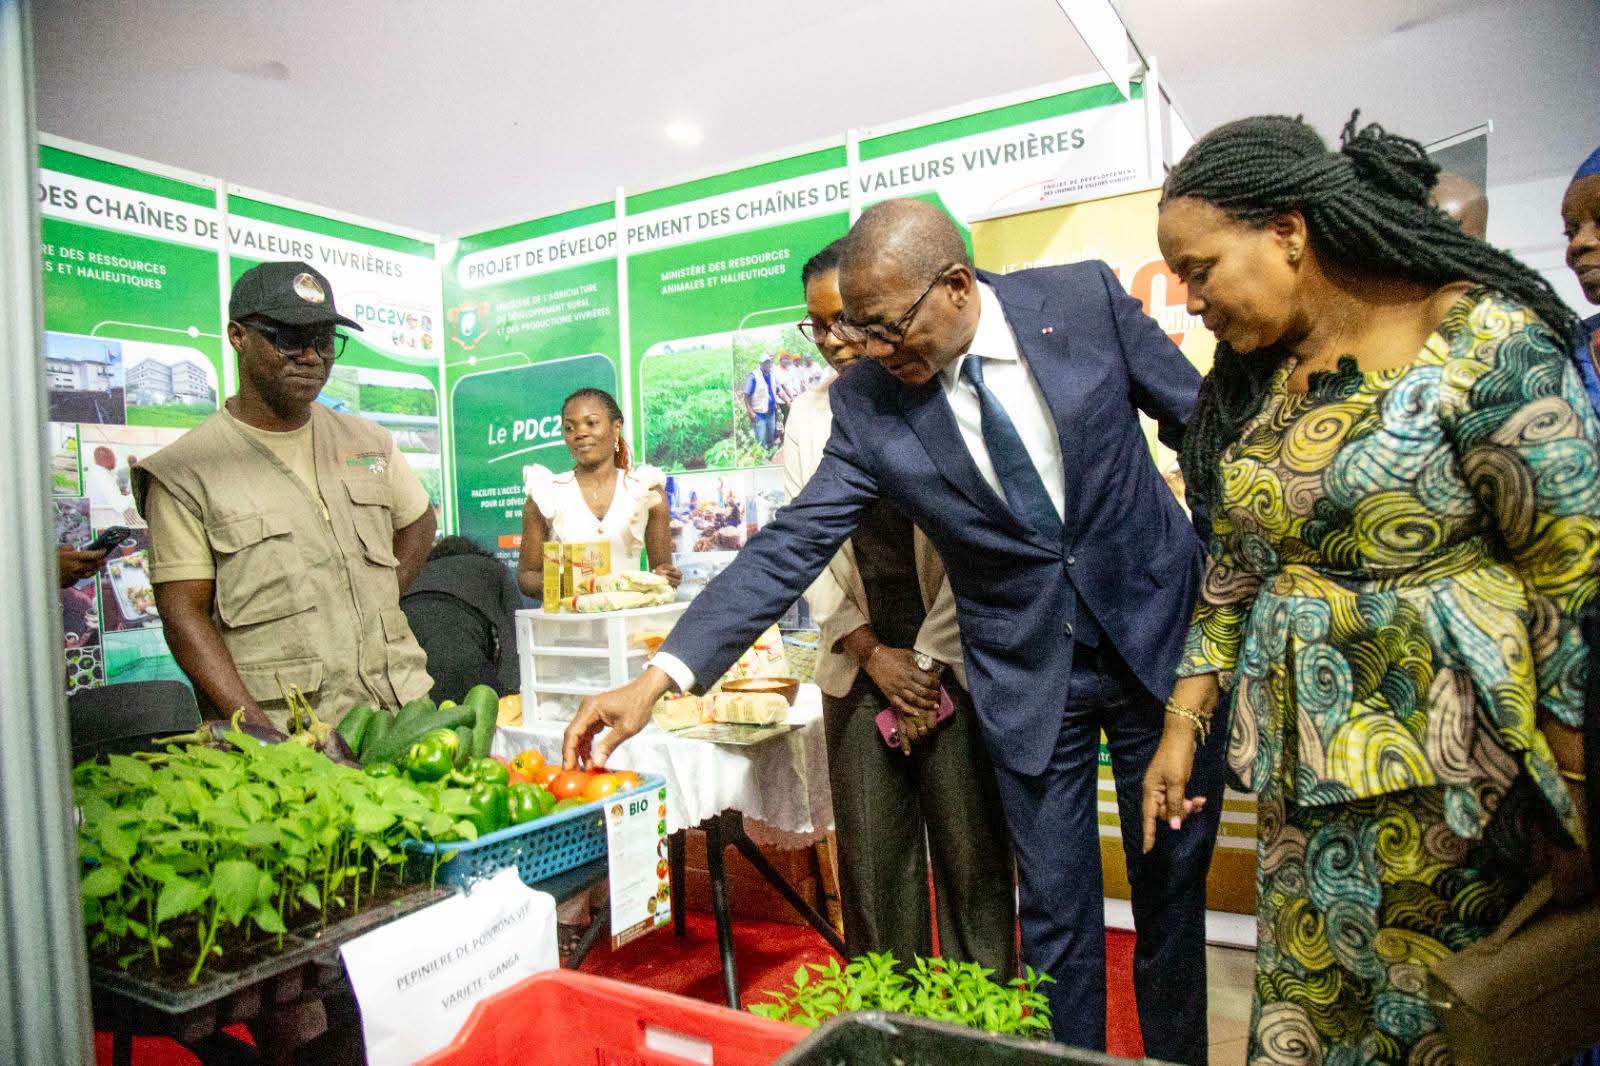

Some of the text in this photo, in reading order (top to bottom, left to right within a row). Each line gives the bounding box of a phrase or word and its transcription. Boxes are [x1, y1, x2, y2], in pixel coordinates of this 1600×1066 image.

[859, 128, 1086, 193] VALEURS VIVRIÈRES
[86, 194, 188, 234] CHAÎNES
[194, 218, 219, 240] DE
[697, 206, 730, 230] DES
[735, 188, 819, 221] CHAÎNES
[825, 180, 850, 202] DE
[59, 246, 85, 261] DES
[88, 251, 167, 276] RESSOURCES
[228, 226, 403, 279] VALEURS VIVRIÈRES
[468, 253, 521, 279] PROJET
[525, 248, 544, 267] DE
[660, 248, 790, 281] MINISTÈRE DES RESSOURCES
[57, 262, 73, 275] ET
[76, 265, 162, 290] HALIEUTIQUES
[661, 263, 786, 295] ANIMALES ET HALIEUTIQUES
[356, 303, 406, 326] PDC2V
[488, 423, 507, 445] Le
[629, 799, 648, 817] BIO
[396, 951, 453, 991] PEPINIERE
[455, 943, 471, 960] DE
[488, 952, 520, 981] GANGA
